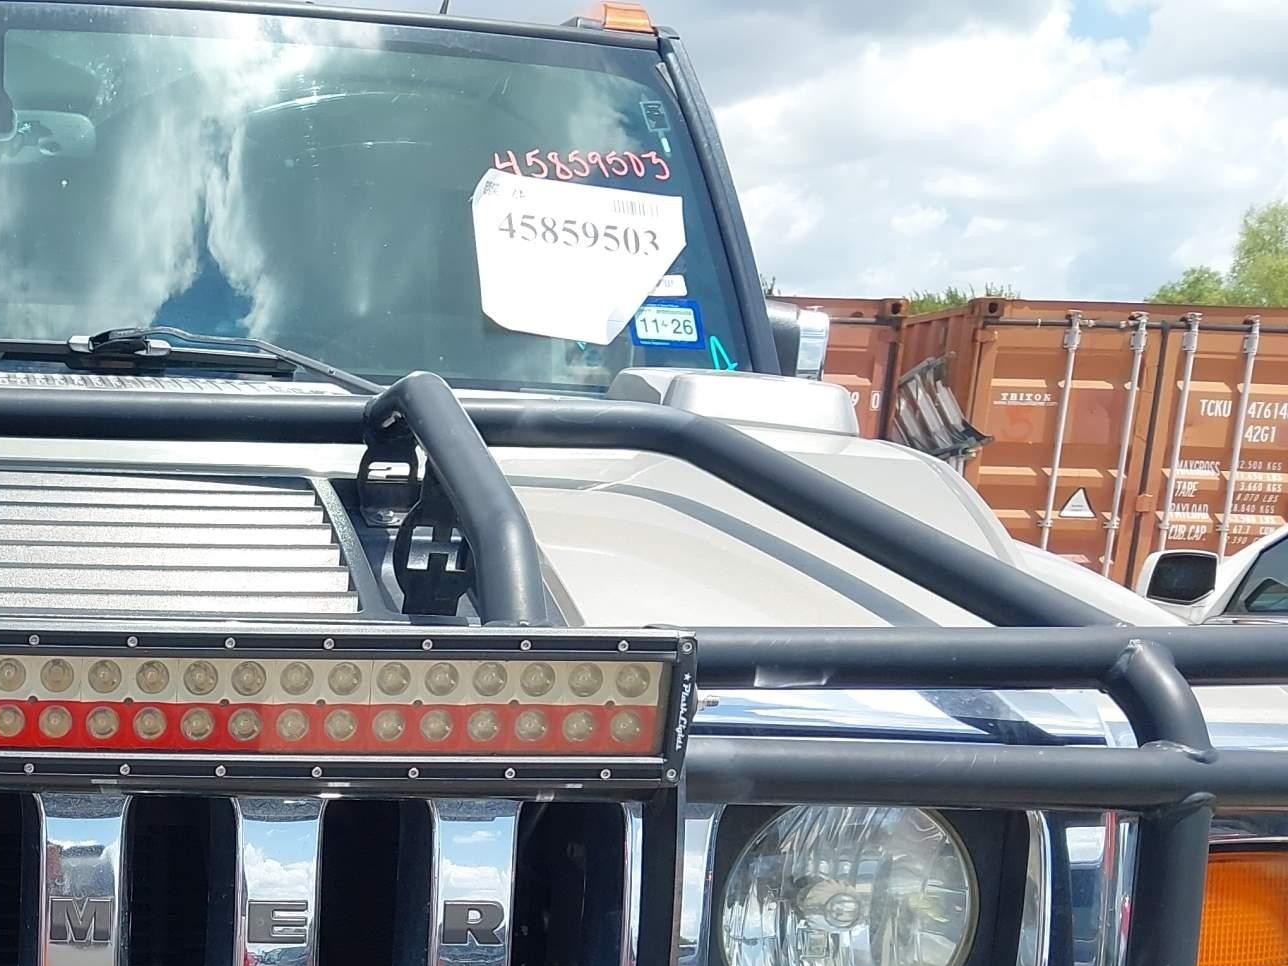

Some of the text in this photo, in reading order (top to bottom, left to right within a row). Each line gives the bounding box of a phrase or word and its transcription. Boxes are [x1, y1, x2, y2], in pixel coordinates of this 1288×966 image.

[494, 150, 670, 180] 45859503
[498, 212, 660, 256] 45859503
[1000, 392, 1052, 401] TRITON
[1200, 399, 1288, 420] TCKU 47614
[1244, 425, 1276, 443] 42G1
[1174, 481, 1200, 497] TARE
